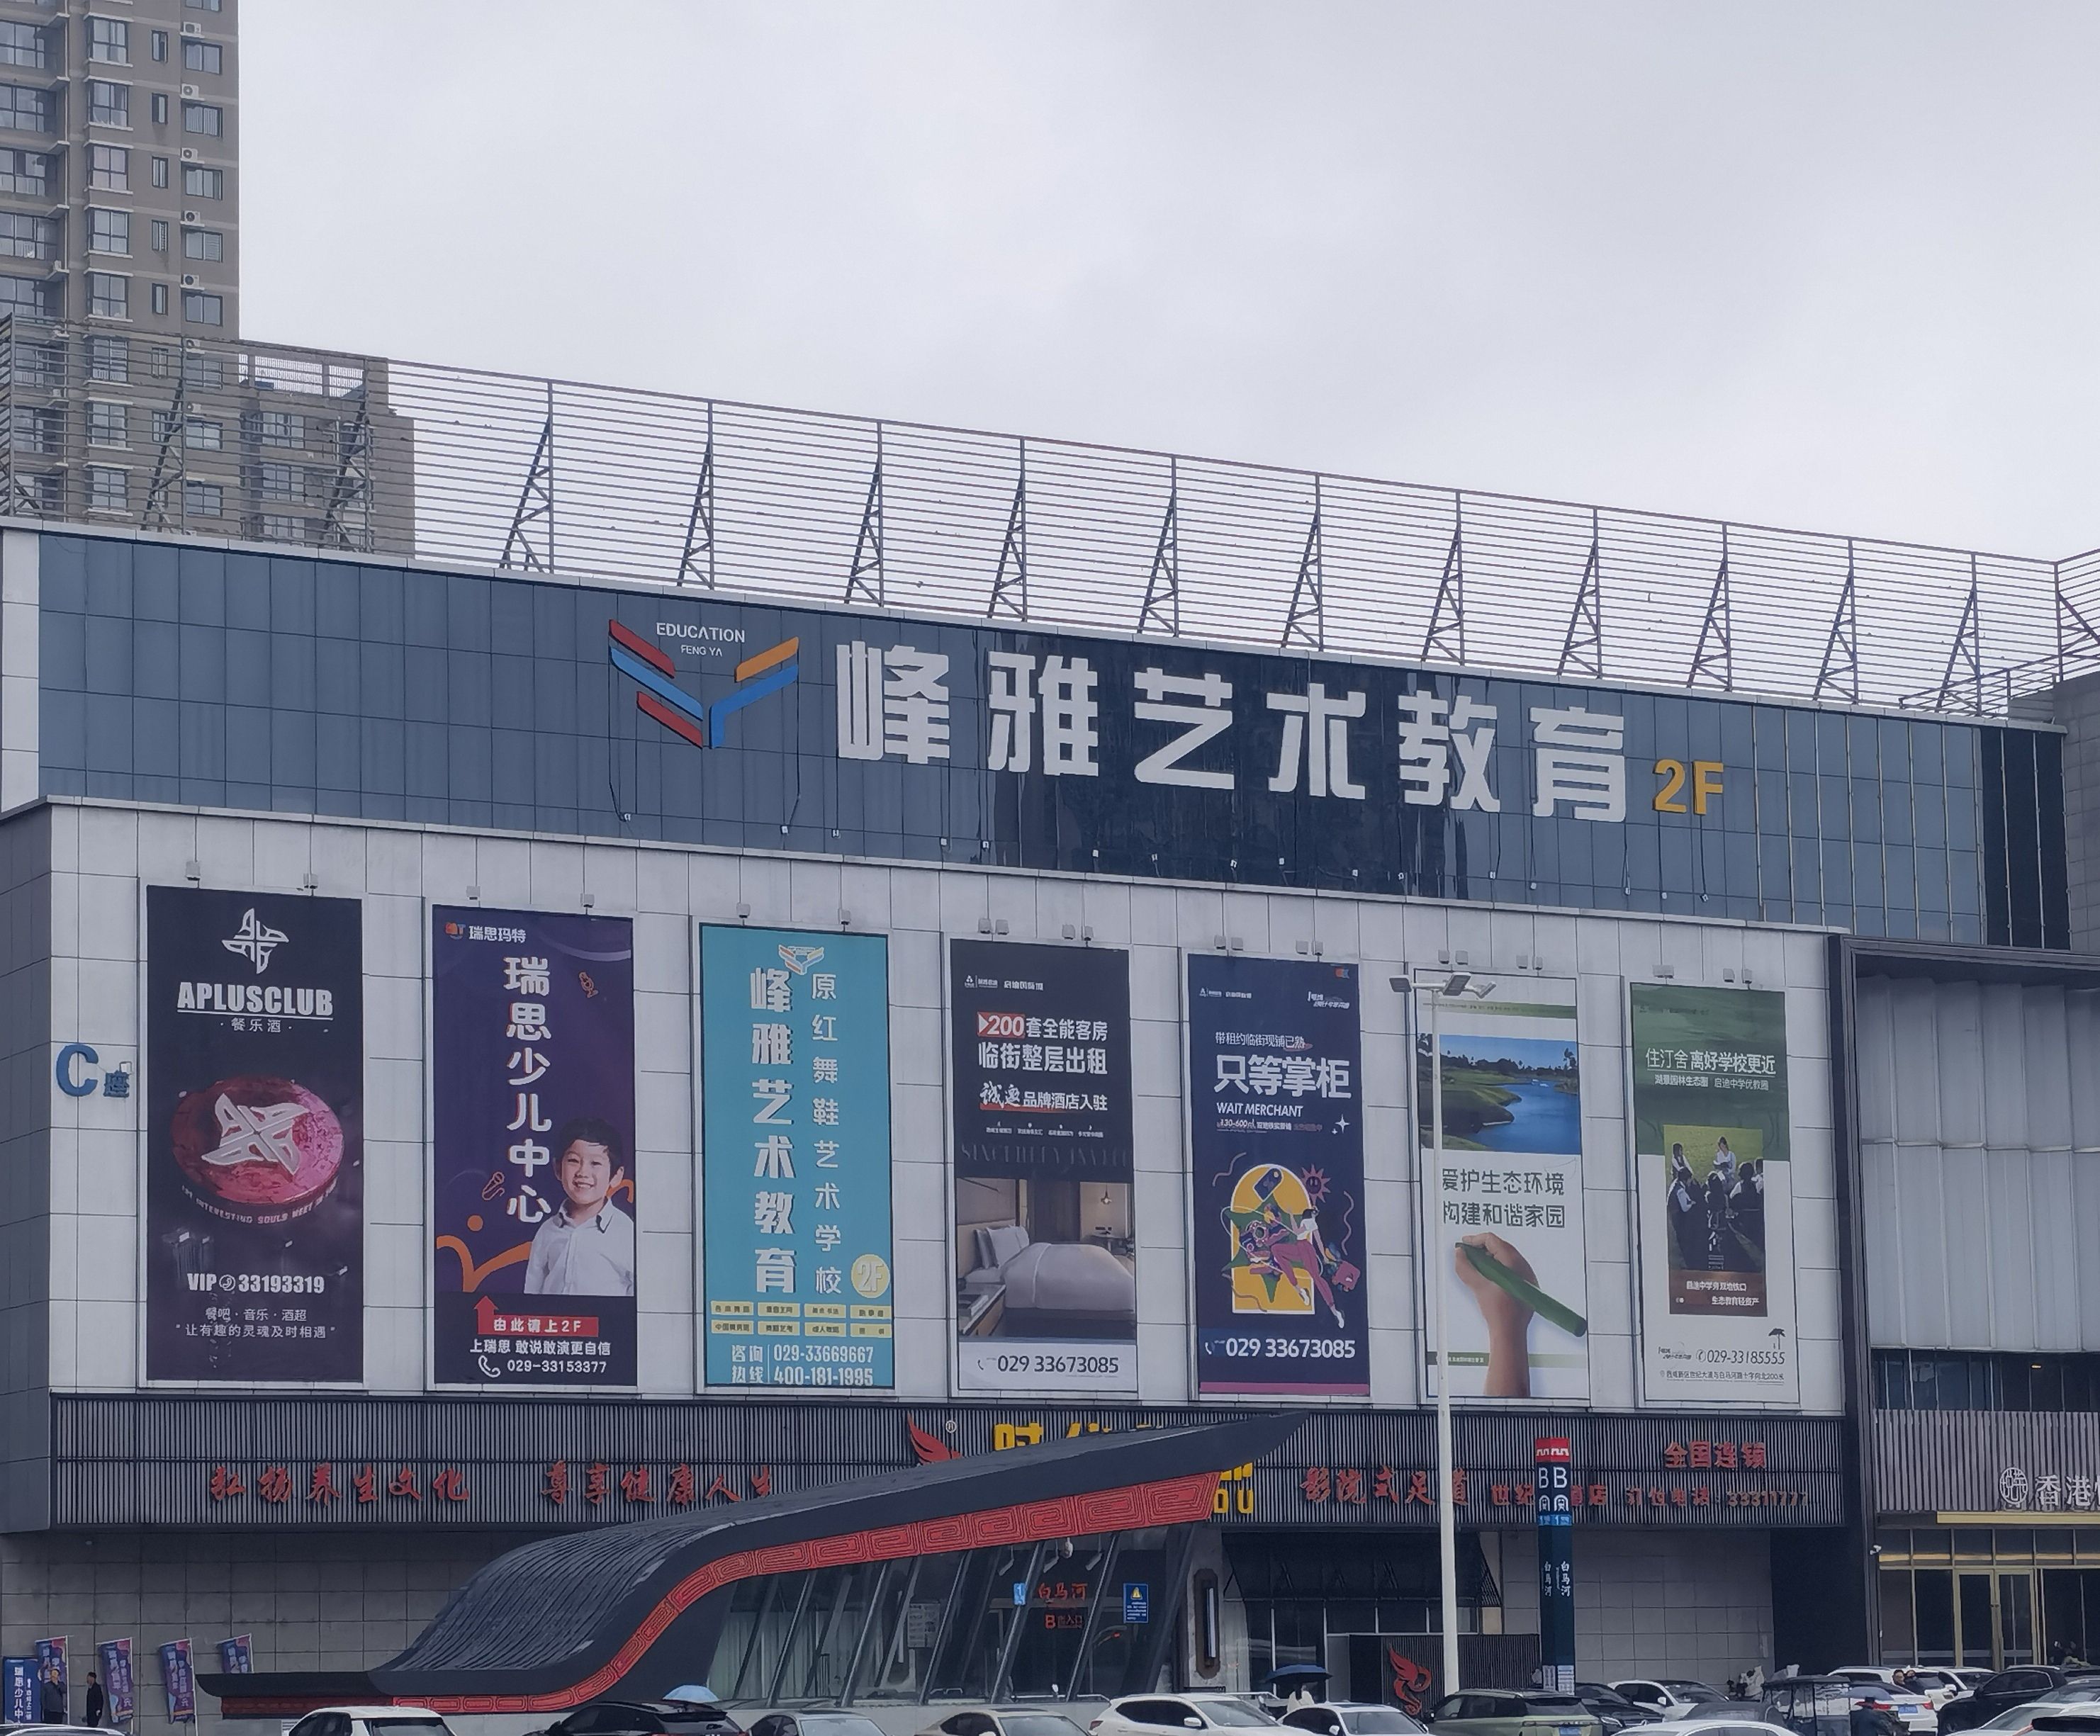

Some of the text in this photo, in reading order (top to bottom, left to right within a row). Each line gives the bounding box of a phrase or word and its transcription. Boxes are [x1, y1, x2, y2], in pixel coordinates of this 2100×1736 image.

[656, 621, 746, 644] EDUCATION
[680, 643, 723, 658] FENG YA
[836, 640, 1724, 823] 峰雅艺术教育 2F
[468, 925, 527, 944] 瑞思玛特
[176, 981, 333, 1016] APLUSCLUB
[231, 1017, 281, 1034] 餐乐酒
[978, 1042, 1108, 1075] 临街整层出租
[1646, 1047, 1776, 1075] 住汀舍 离好学校更近
[1214, 1054, 1352, 1099] 只等掌柜
[502, 956, 552, 1223] 瑞思少儿中心
[1216, 1103, 1303, 1117] WAIT MERCHANT
[750, 967, 797, 1294] 峰雅艺术教育
[812, 973, 843, 1295] 原红舞鞋艺术学校
[1442, 1168, 1565, 1197] 爱护生态环境
[1443, 1200, 1565, 1229] 构建和谐家园
[187, 1273, 325, 1294] VIP 33193319
[858, 1260, 885, 1293] 2F
[470, 1338, 611, 1356] 上瑞思 敢说敢演更自信
[731, 1344, 873, 1363] 咨询 029-33669667
[1226, 1338, 1356, 1359] 029 33673085
[1707, 1349, 1785, 1365] 029-33185555
[507, 1359, 607, 1373] 029-33153377
[997, 1355, 1119, 1374] 029 33673085
[731, 1365, 873, 1387] 热线 400-181-1995
[1664, 1441, 1766, 1470] 全国连锁
[1539, 1467, 1549, 1488] B
[1554, 1466, 1568, 1488] B
[2034, 1474, 2100, 1506] 香港
[1561, 1560, 1571, 1596] 白马河
[1038, 1583, 1087, 1599] 白马河
